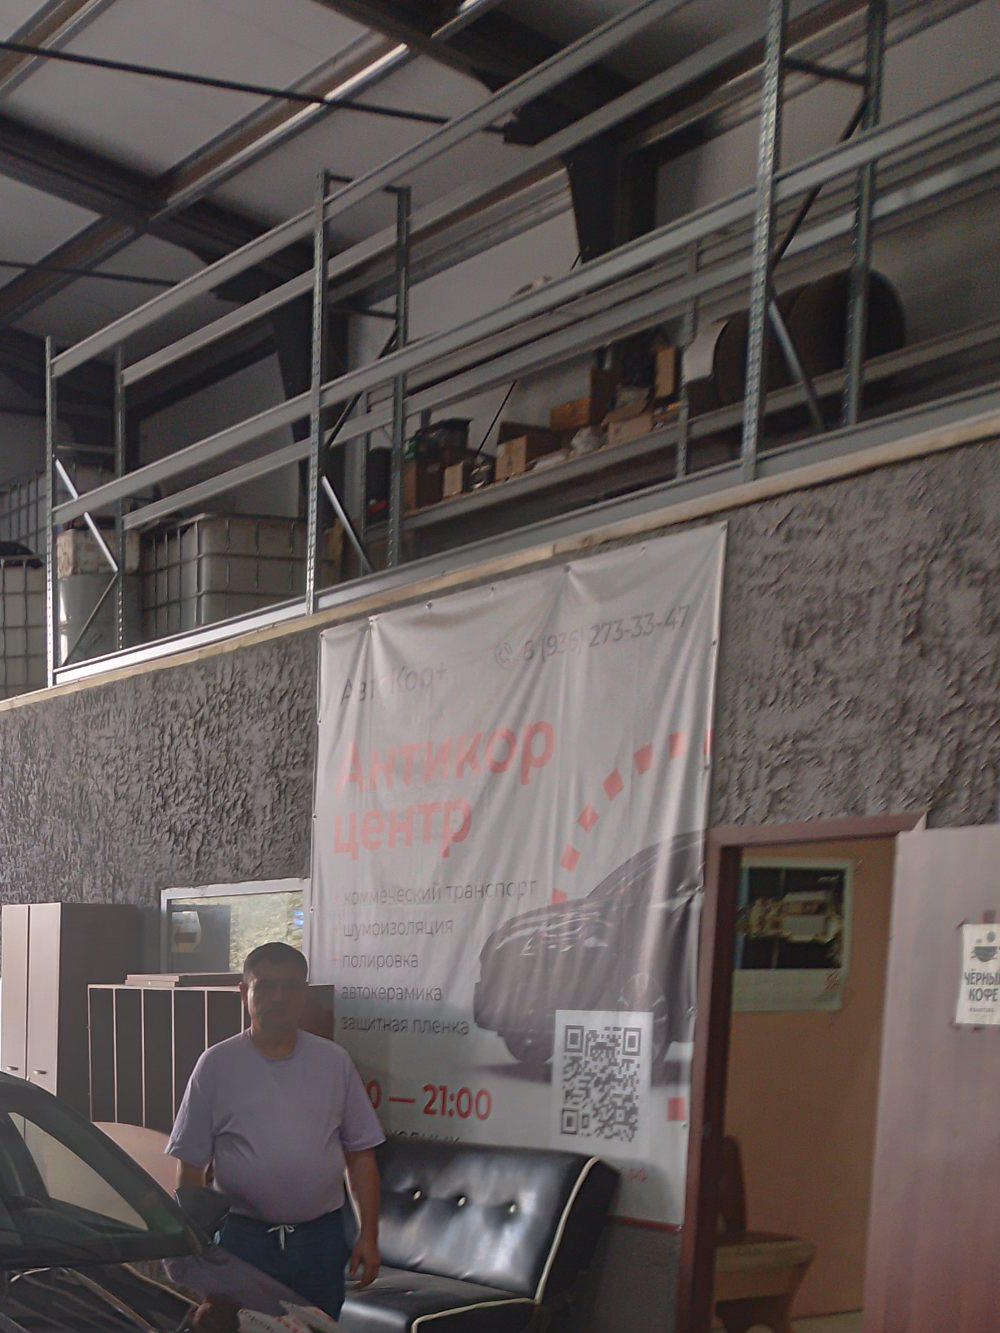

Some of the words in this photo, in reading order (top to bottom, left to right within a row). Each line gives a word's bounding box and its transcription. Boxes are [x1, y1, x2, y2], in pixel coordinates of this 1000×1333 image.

[334, 720, 556, 796] Антикор
[333, 797, 473, 861] центр
[446, 880, 538, 905] транспорт
[343, 919, 453, 942] шумоизоляция
[342, 953, 419, 971] полировка
[341, 984, 442, 1003] автокерамика
[969, 987, 999, 1002] КОФЕ
[341, 1015, 408, 1033] защитная
[423, 1083, 493, 1120] 21:00
